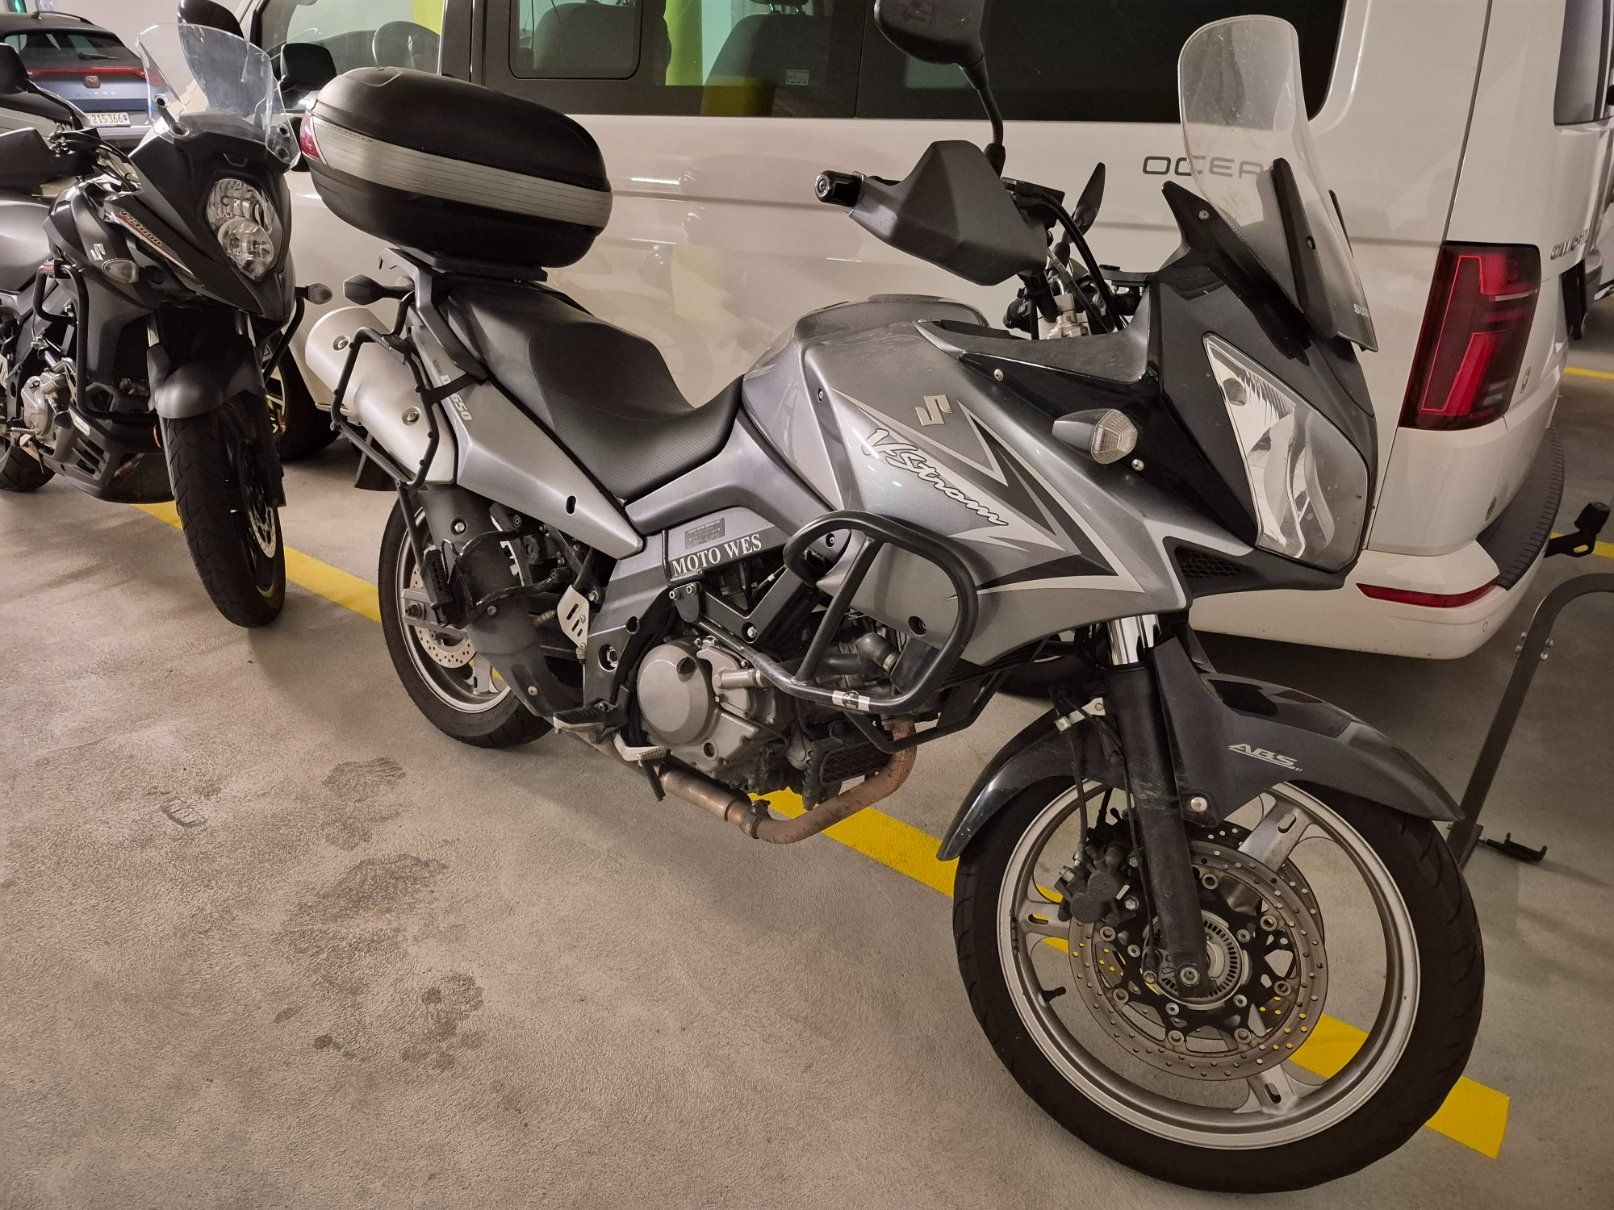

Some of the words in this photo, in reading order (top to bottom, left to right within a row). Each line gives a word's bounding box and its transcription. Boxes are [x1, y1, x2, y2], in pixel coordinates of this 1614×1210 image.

[1143, 156, 1267, 178] OCEA
[672, 547, 721, 577] MOTO
[723, 533, 762, 559] WES
[1228, 743, 1299, 769] ABS
